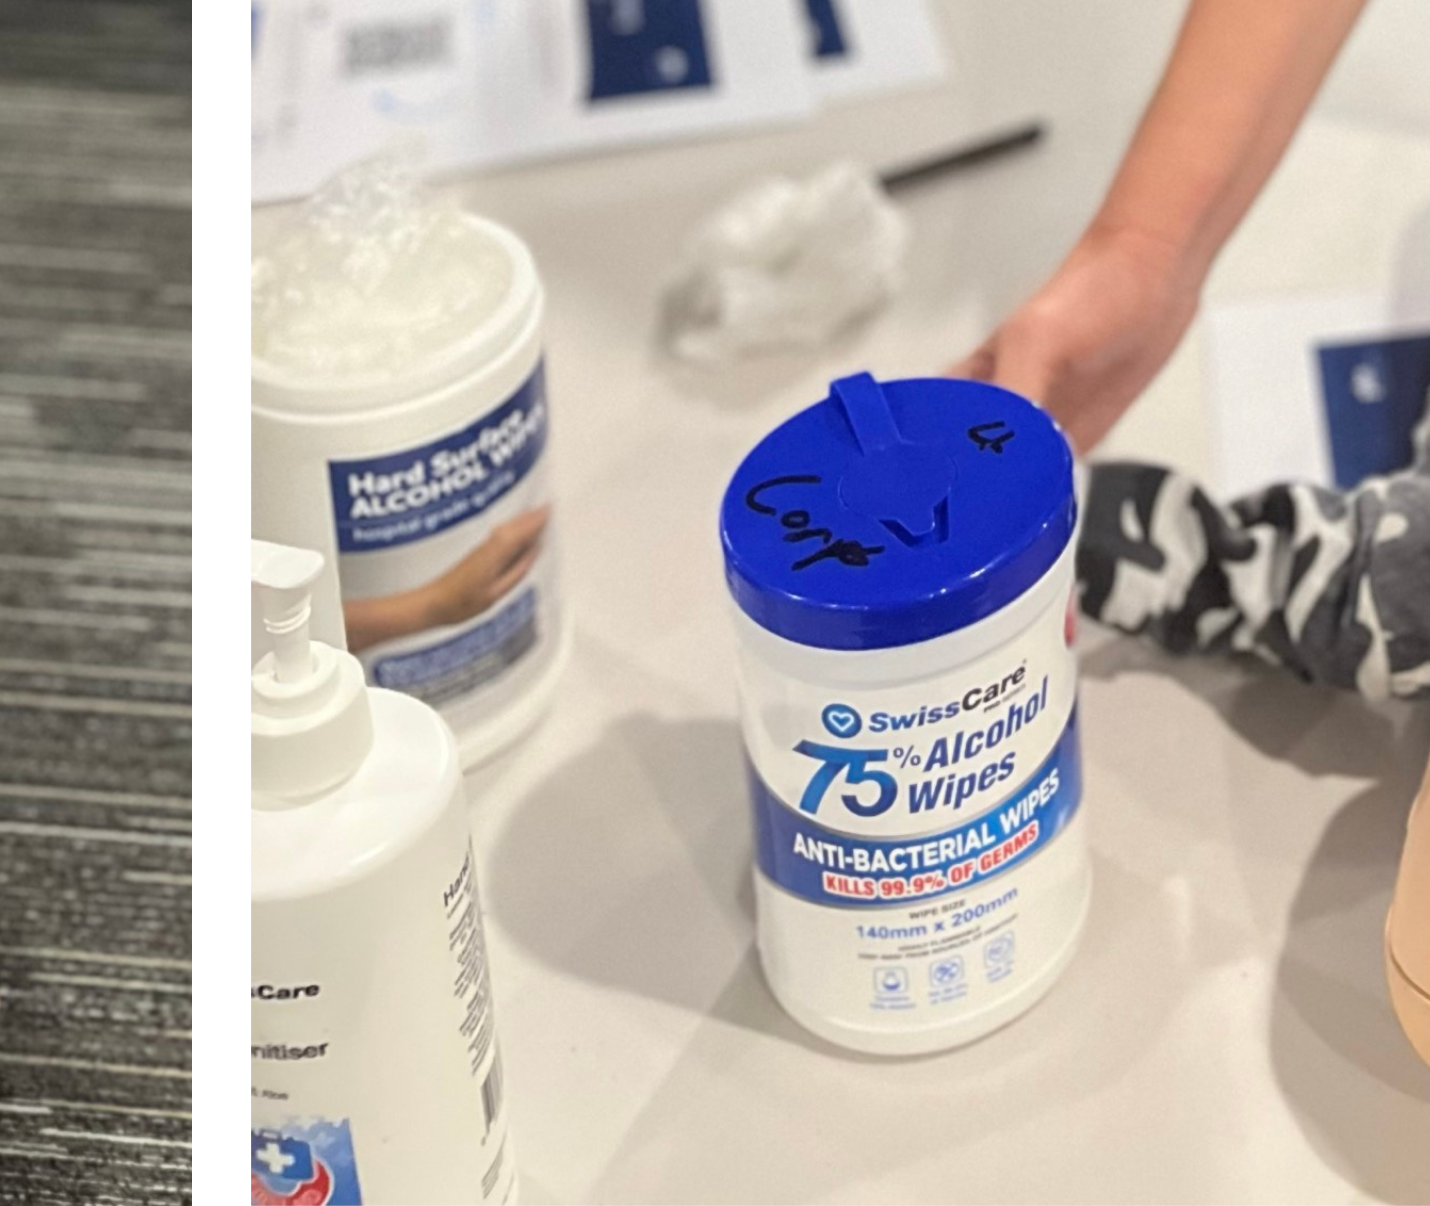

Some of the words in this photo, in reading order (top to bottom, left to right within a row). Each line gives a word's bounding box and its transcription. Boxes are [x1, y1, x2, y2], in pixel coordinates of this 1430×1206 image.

[348, 459, 426, 496] Hard
[350, 460, 488, 519] ALCOHOL
[869, 665, 1027, 733] SwissCare
[922, 674, 1049, 773] Alcohol
[908, 751, 1017, 814] Wipes
[793, 822, 996, 872] ANTI-BACTERIAL
[999, 767, 1060, 834] WIPES
[825, 875, 874, 896] KILLS
[880, 874, 946, 896] 99.9%
[950, 861, 974, 884] OF
[979, 822, 1038, 872] GERMS
[856, 925, 928, 940] 140mm
[934, 921, 945, 932] x
[951, 887, 1019, 928] 200mm
[909, 907, 938, 920] WIPE
[941, 899, 966, 913] SIZE
